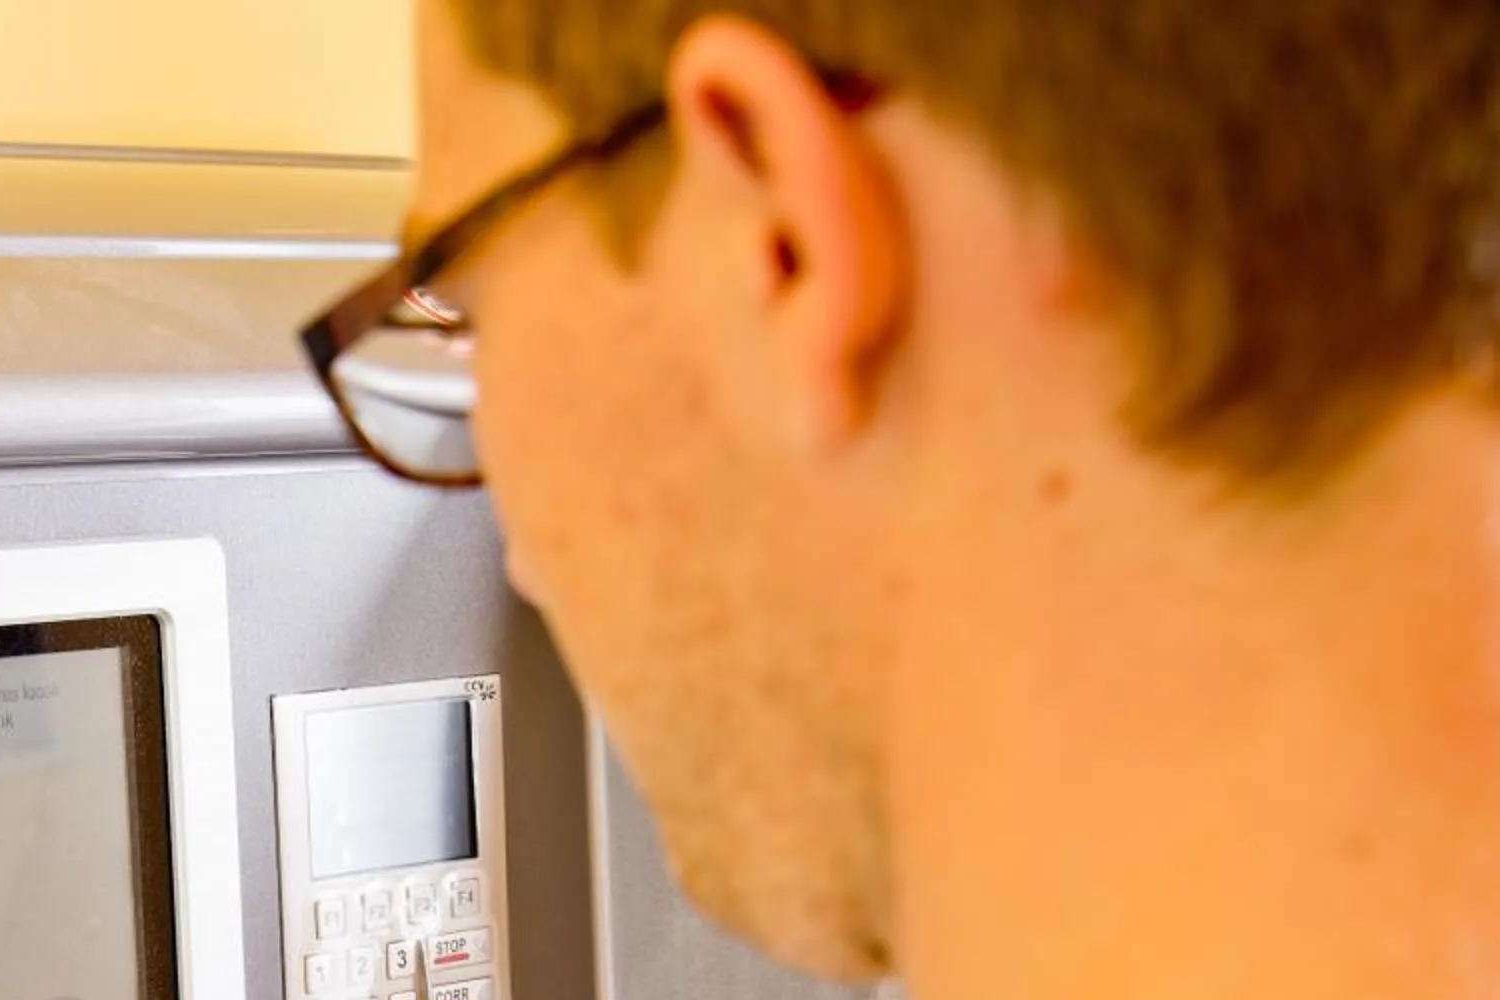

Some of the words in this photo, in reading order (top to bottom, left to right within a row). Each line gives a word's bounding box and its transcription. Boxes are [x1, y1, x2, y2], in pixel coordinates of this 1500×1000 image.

[458, 888, 473, 904] F4
[356, 956, 370, 977] 2
[397, 949, 408, 970] 3
[435, 937, 468, 956] STOP
